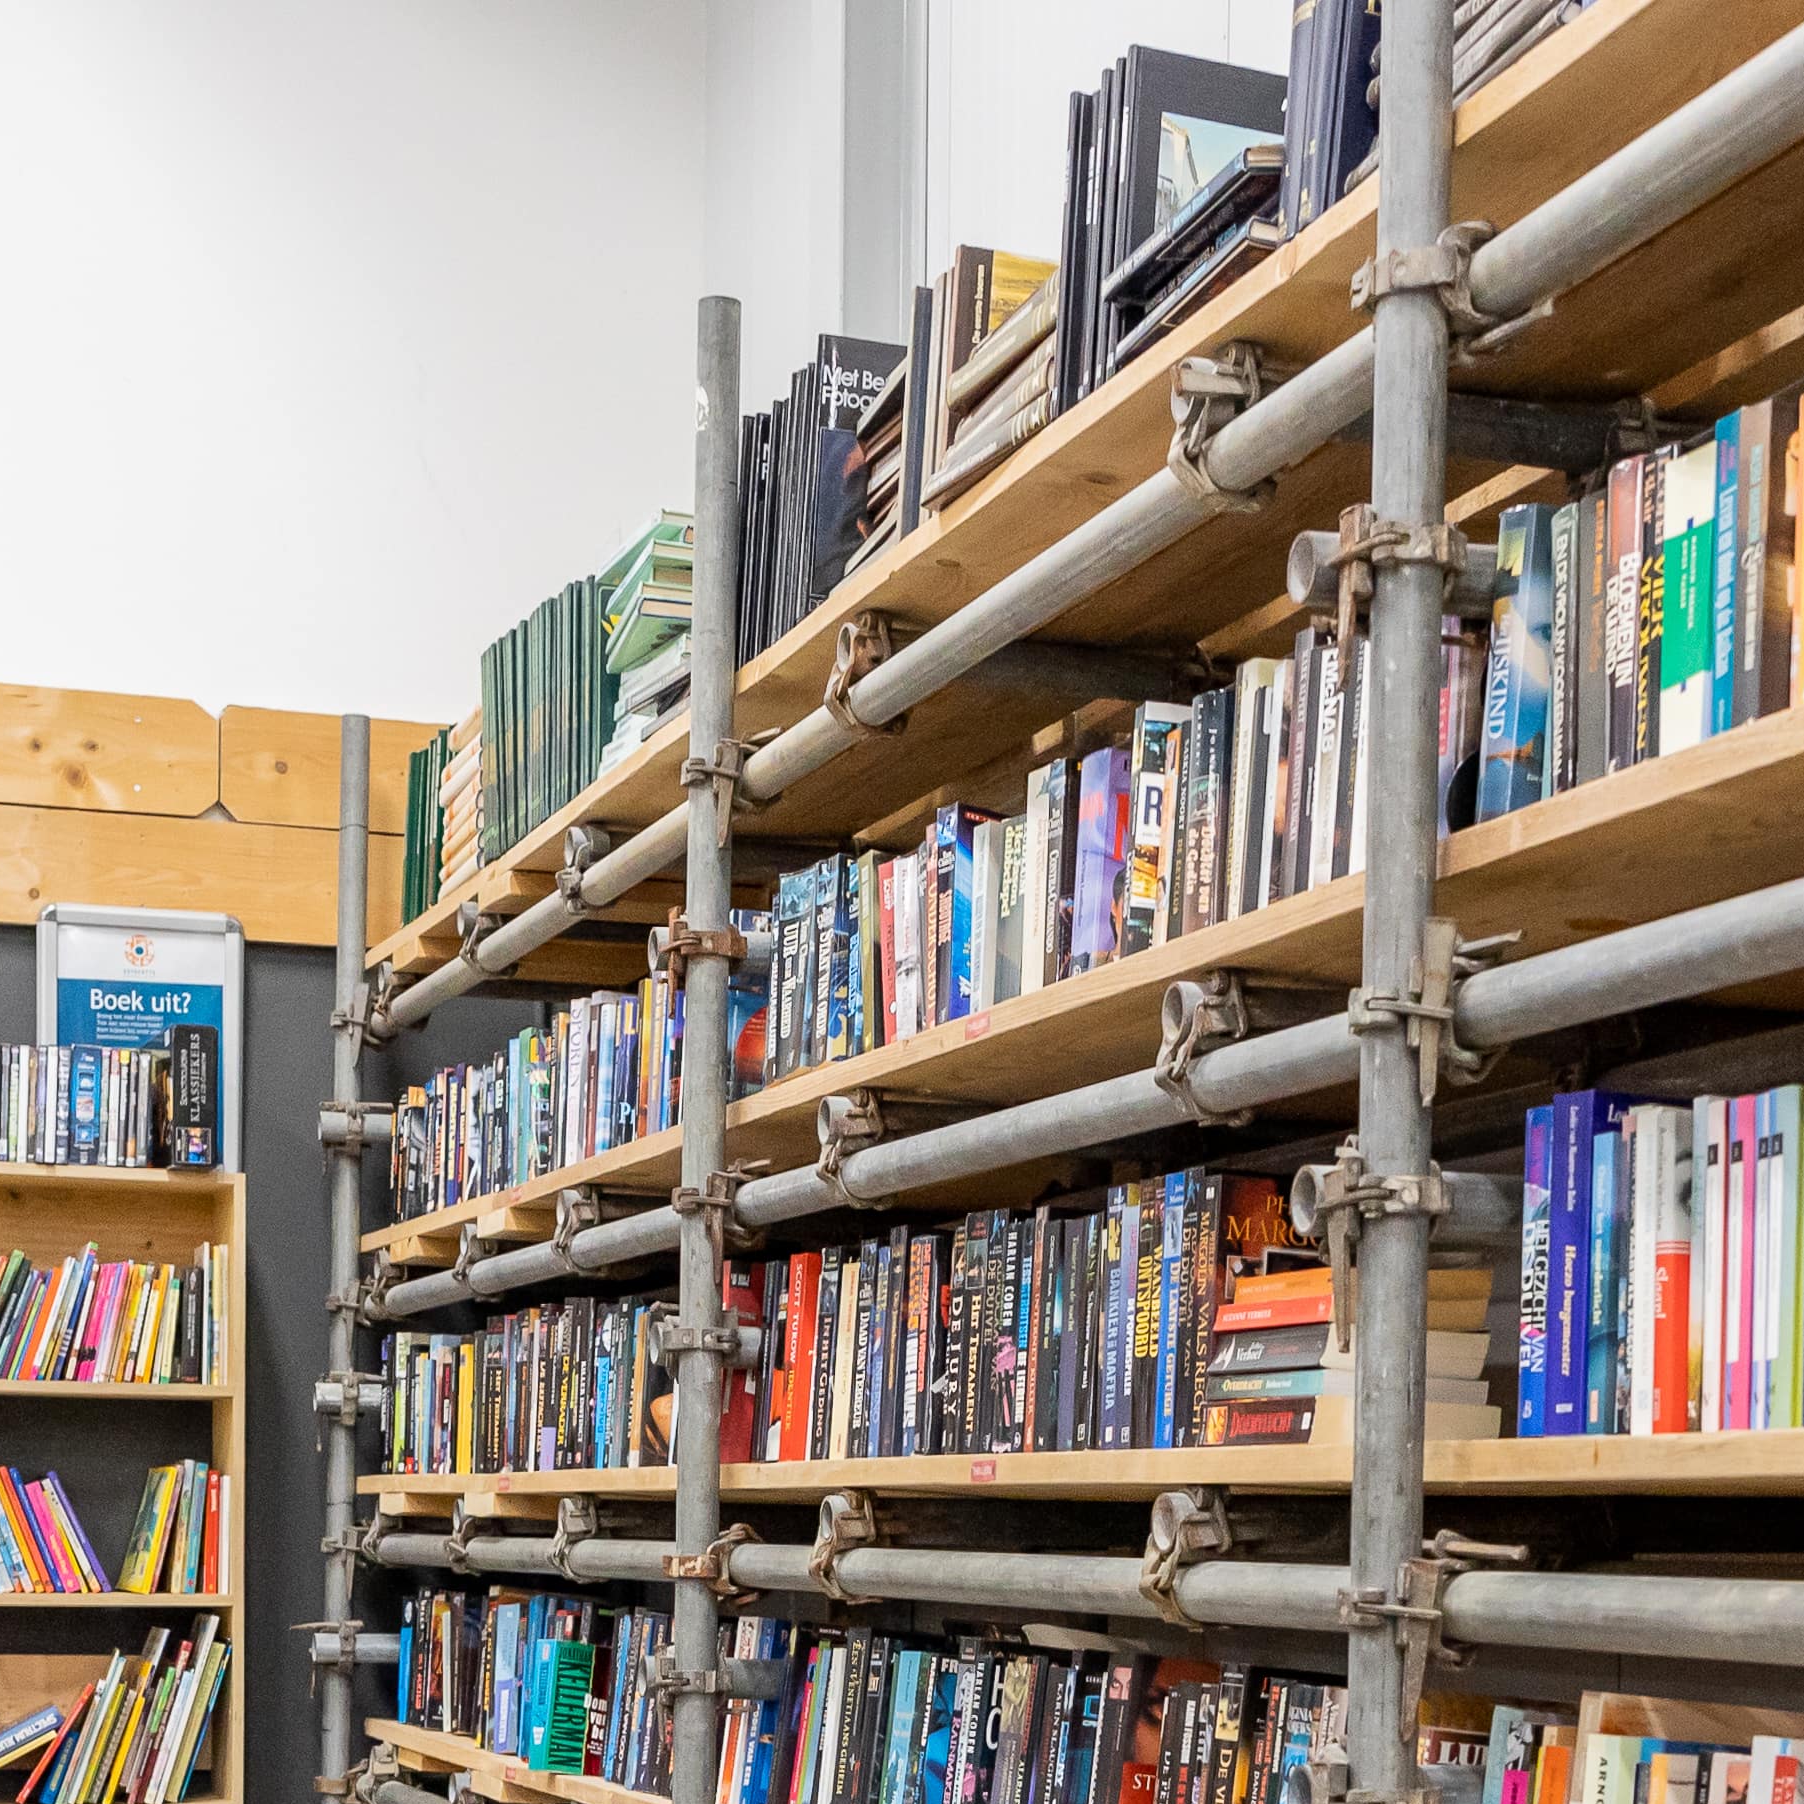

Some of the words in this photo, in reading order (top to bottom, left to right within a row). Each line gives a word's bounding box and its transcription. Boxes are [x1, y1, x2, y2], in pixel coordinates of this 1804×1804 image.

[821, 364, 857, 389] Met
[1617, 552, 1639, 660] BLOEMEN
[1487, 639, 1511, 740] IJSKIND
[1615, 662, 1634, 688] IN
[1321, 663, 1340, 754] McNAB
[1045, 849, 1059, 954] CONTRA-COMMANDO
[782, 921, 799, 959] UUR
[818, 928, 834, 975] STAAT
[90, 988, 145, 1012] Boek
[151, 993, 192, 1014] uit?
[779, 975, 796, 1039] WAARHEID
[817, 973, 831, 1001] VAN
[815, 1001, 829, 1039] ORDE
[190, 1033, 201, 1123] KLASSIEKERS
[1005, 1232, 1018, 1281] HARLAN
[1181, 1228, 1193, 1249] DE
[1196, 1211, 1210, 1296] MARGOLIN
[1535, 1220, 1550, 1252] HET
[793, 1263, 804, 1308] SCOTT
[986, 1259, 998, 1283] DE
[1170, 1262, 1182, 1284] DE
[1564, 1245, 1576, 1287] Hoezo
[950, 1295, 964, 1334] DE
[970, 1294, 982, 1329] HET
[1002, 1285, 1015, 1327] COBEN
[1106, 1268, 1121, 1338] BANKIER
[1126, 1298, 1136, 1312] DE
[1134, 1256, 1153, 1358] ONTSPOORD
[1148, 1244, 1162, 1358] WAANBEELD
[1177, 1256, 1190, 1327] DUIVEL
[1533, 1256, 1549, 1329] GEZICHT
[788, 1312, 800, 1364] TUROW
[823, 1316, 832, 1336] IN
[858, 1311, 871, 1345] DAAD
[983, 1290, 996, 1346] DUIVEL
[1166, 1288, 1180, 1349] LAATSTE
[1196, 1302, 1209, 1356] VALS
[1559, 1290, 1575, 1376] burgemeester
[561, 1355, 570, 1374] DE
[821, 1339, 831, 1368] HET
[856, 1347, 868, 1370] VAN
[1123, 1314, 1135, 1396] POPPENSPELER
[1531, 1333, 1545, 1373] VAN
[494, 1370, 503, 1396] HET
[785, 1369, 795, 1431] IDENTIEK
[852, 1372, 867, 1429] TERREUR
[947, 1343, 962, 1416] JURY
[965, 1333, 980, 1432] TESTAMENT
[1104, 1351, 1119, 1410] MAFFIA
[1163, 1353, 1177, 1417] GETUIGE
[1191, 1361, 1205, 1434] RECHT
[492, 1398, 501, 1460] TESTAMENT
[557, 1376, 568, 1446] VERRADER
[816, 1372, 828, 1438] GEDING
[972, 1663, 985, 1708] HARLAN
[1051, 1682, 1065, 1726] KARIN
[547, 1662, 587, 1767] KELLERMAN
[966, 1714, 979, 1754] COBEN
[1217, 1749, 1233, 1778] DE
